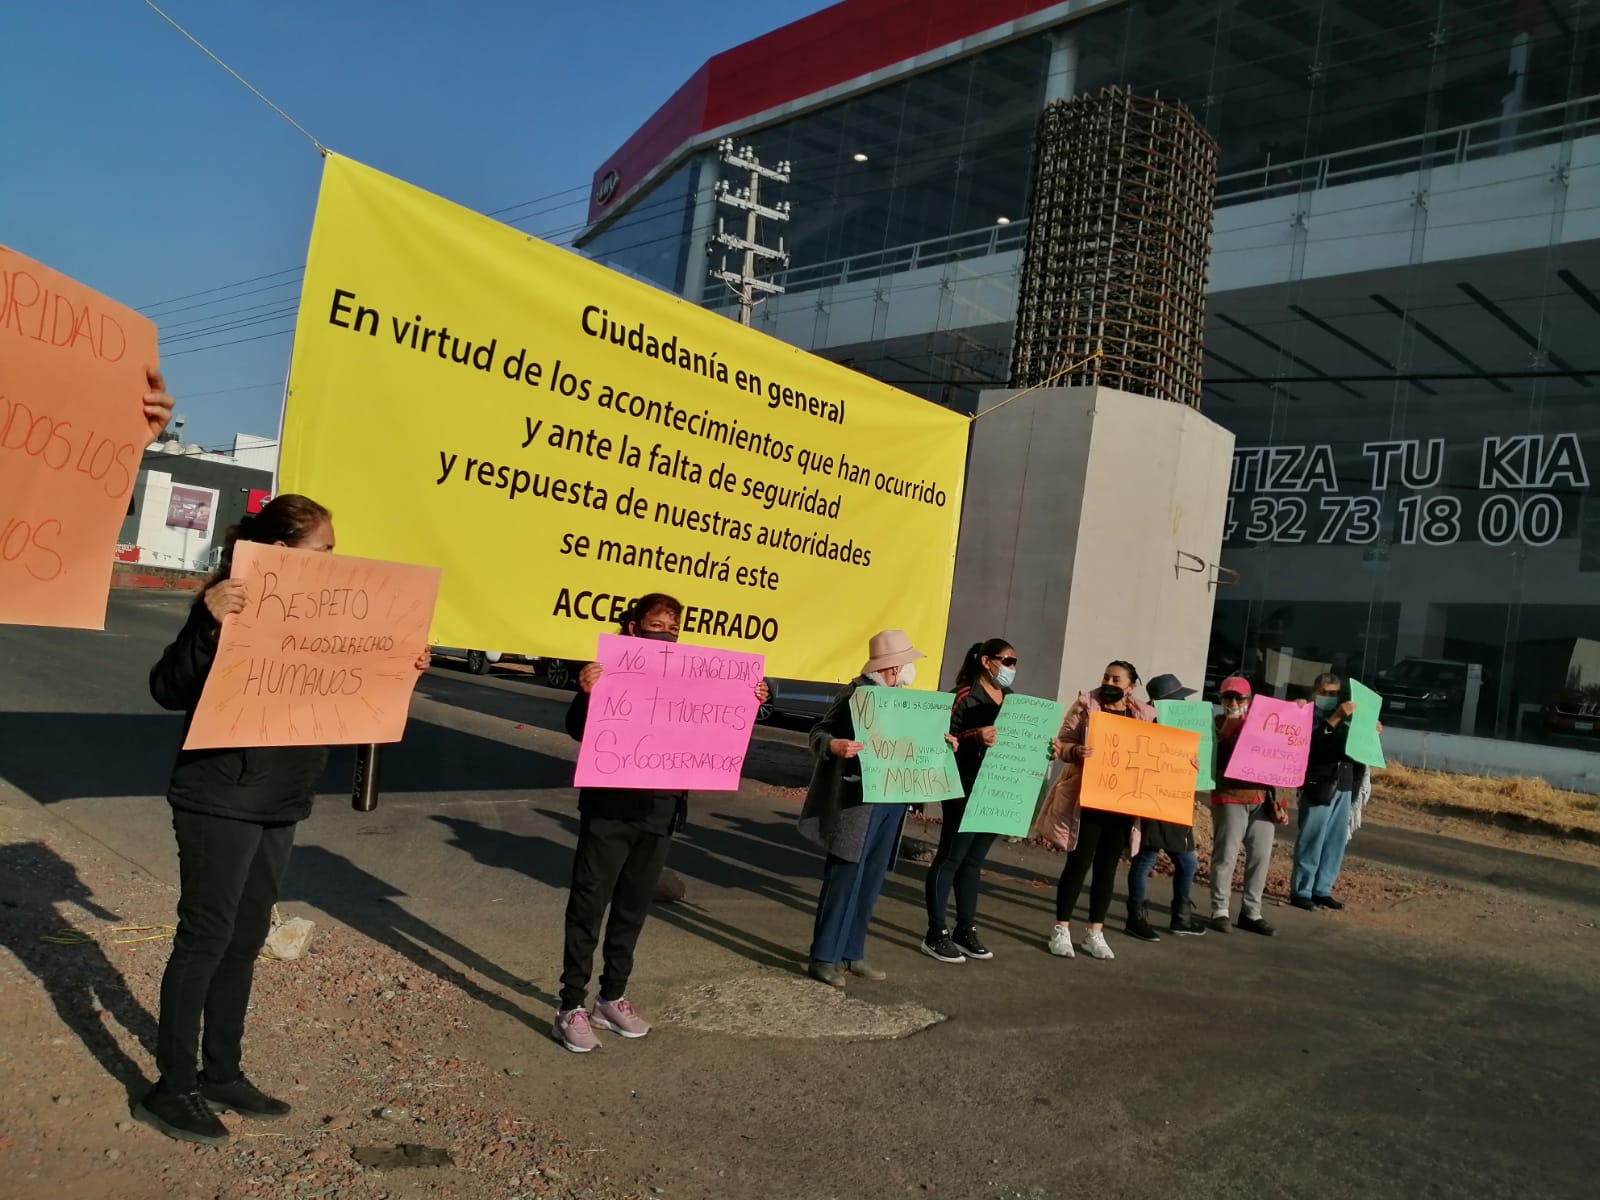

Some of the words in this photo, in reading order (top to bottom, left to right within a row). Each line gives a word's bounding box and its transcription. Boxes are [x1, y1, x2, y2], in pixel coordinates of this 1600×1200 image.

[581, 305, 729, 384] Ciudadanía
[735, 370, 762, 396] en
[767, 382, 845, 425] general
[329, 288, 380, 337] En
[392, 314, 497, 373] virtud
[503, 348, 543, 387] de
[550, 359, 592, 402] los
[596, 382, 794, 465] acontecimientos
[797, 449, 834, 475] que
[837, 453, 871, 487] han
[874, 473, 946, 507] ocurrido
[77, 431, 135, 499] LOS
[521, 416, 543, 449] y
[547, 424, 612, 460] ante
[618, 434, 641, 469] la
[648, 443, 702, 484] falta
[708, 462, 737, 493] de
[741, 477, 842, 519] seguridad
[1232, 444, 1339, 492] TIZA
[1363, 438, 1445, 491] TU
[1479, 433, 1590, 489] KIA
[436, 451, 458, 485] y
[464, 457, 608, 511] respuesta
[615, 487, 648, 519] de
[654, 502, 753, 542] nuestras
[756, 526, 872, 567] autoridades
[1246, 496, 1307, 543] 32
[1317, 495, 1381, 544] 73
[1398, 495, 1462, 546] 18
[1478, 493, 1563, 547] 00
[0, 517, 67, 581] OS.
[559, 533, 590, 558] se
[597, 539, 730, 582] mantendrá
[735, 566, 779, 591] este
[256, 571, 369, 622] RESPETO
[552, 587, 641, 624] ACCE
[682, 605, 779, 642] ERRADO
[243, 657, 363, 697] HUMANOS
[616, 647, 646, 672] NO
[679, 654, 761, 689] TRAGEDIAS
[603, 689, 633, 716] NO
[668, 697, 746, 731] MUERTES
[855, 690, 876, 731] YO
[871, 739, 897, 760] VOY
[904, 742, 916, 762] A
[1104, 733, 1120, 748] NO
[1098, 773, 1118, 790] NO
